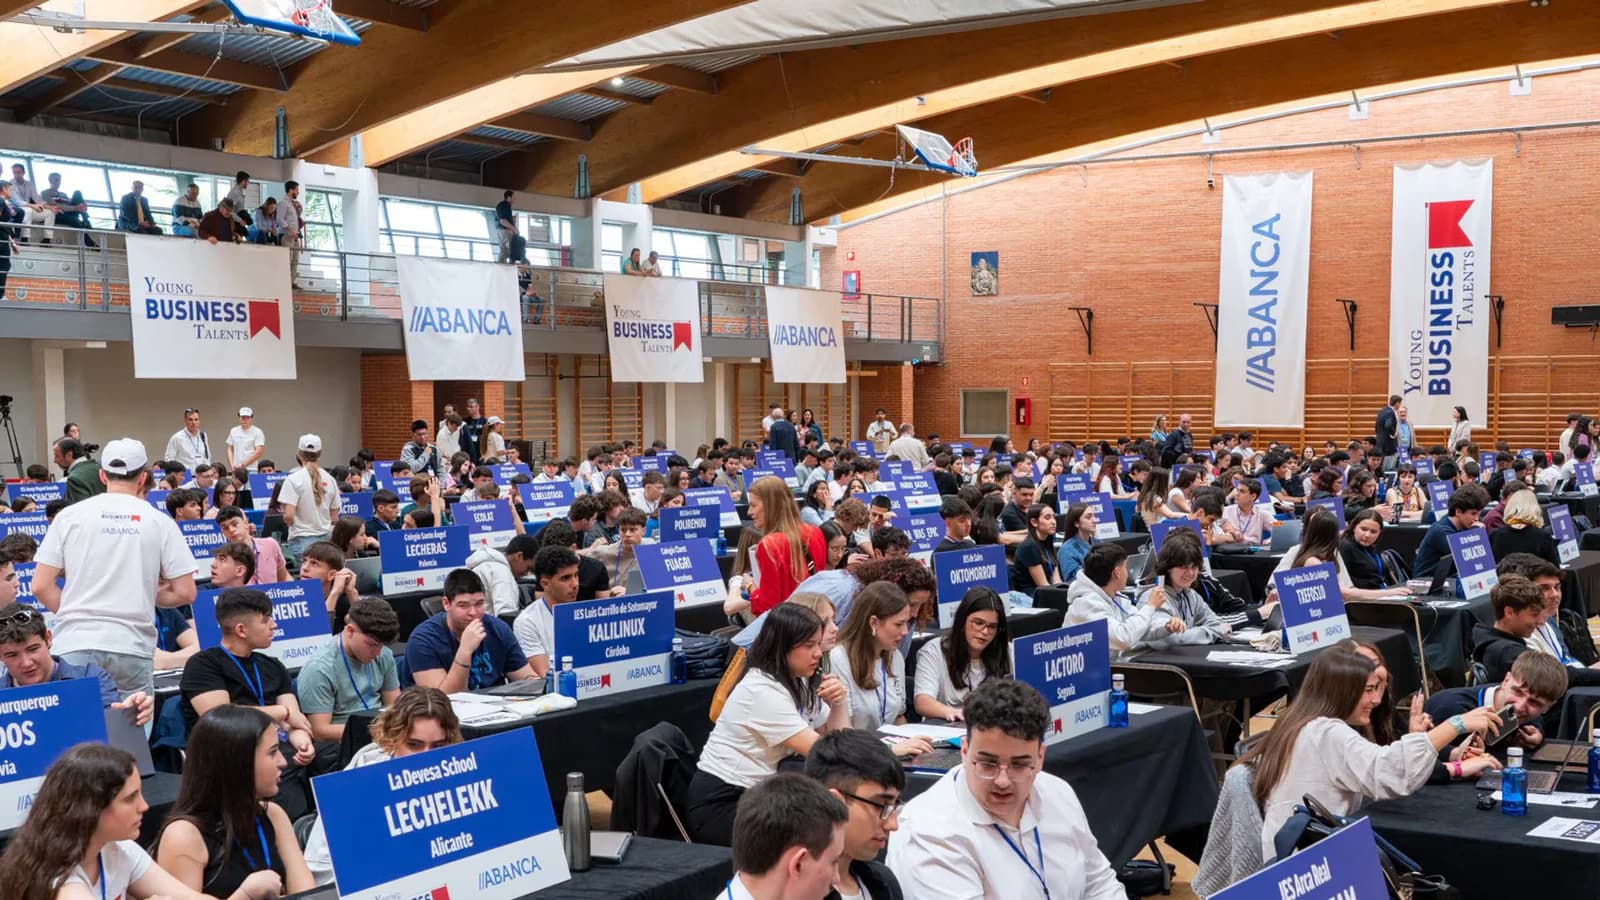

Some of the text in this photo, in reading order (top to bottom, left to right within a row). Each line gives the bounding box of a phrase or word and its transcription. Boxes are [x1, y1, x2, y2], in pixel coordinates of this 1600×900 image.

[145, 299, 248, 323] BUSINESS
[614, 322, 672, 340] BUSINESS
[1428, 252, 1454, 396] BUSINESS
[185, 534, 228, 546] EENFRIDAY
[406, 542, 447, 557] LECHERAS
[664, 556, 692, 572] FUAGRI
[950, 564, 997, 584] OKTOMORROW
[574, 601, 657, 620] IES Luis Carrillo de Sotomayor
[588, 618, 645, 643] KALILINUX
[605, 644, 630, 658] Córdoba
[1033, 642, 1042, 656] IES
[1042, 640, 1057, 655] Duque
[1058, 637, 1064, 650] de
[1045, 652, 1084, 682] LACTORO
[576, 677, 600, 688] USINESS
[1057, 683, 1076, 700] Segovia
[0, 694, 59, 714] urquerque
[387, 752, 478, 791] La Devesa School
[384, 778, 500, 838] LECHELEKK
[430, 831, 474, 859] Alicante
[1278, 876, 1296, 900] IES
[1294, 868, 1313, 896] Arca
[1311, 856, 1332, 887] Real
